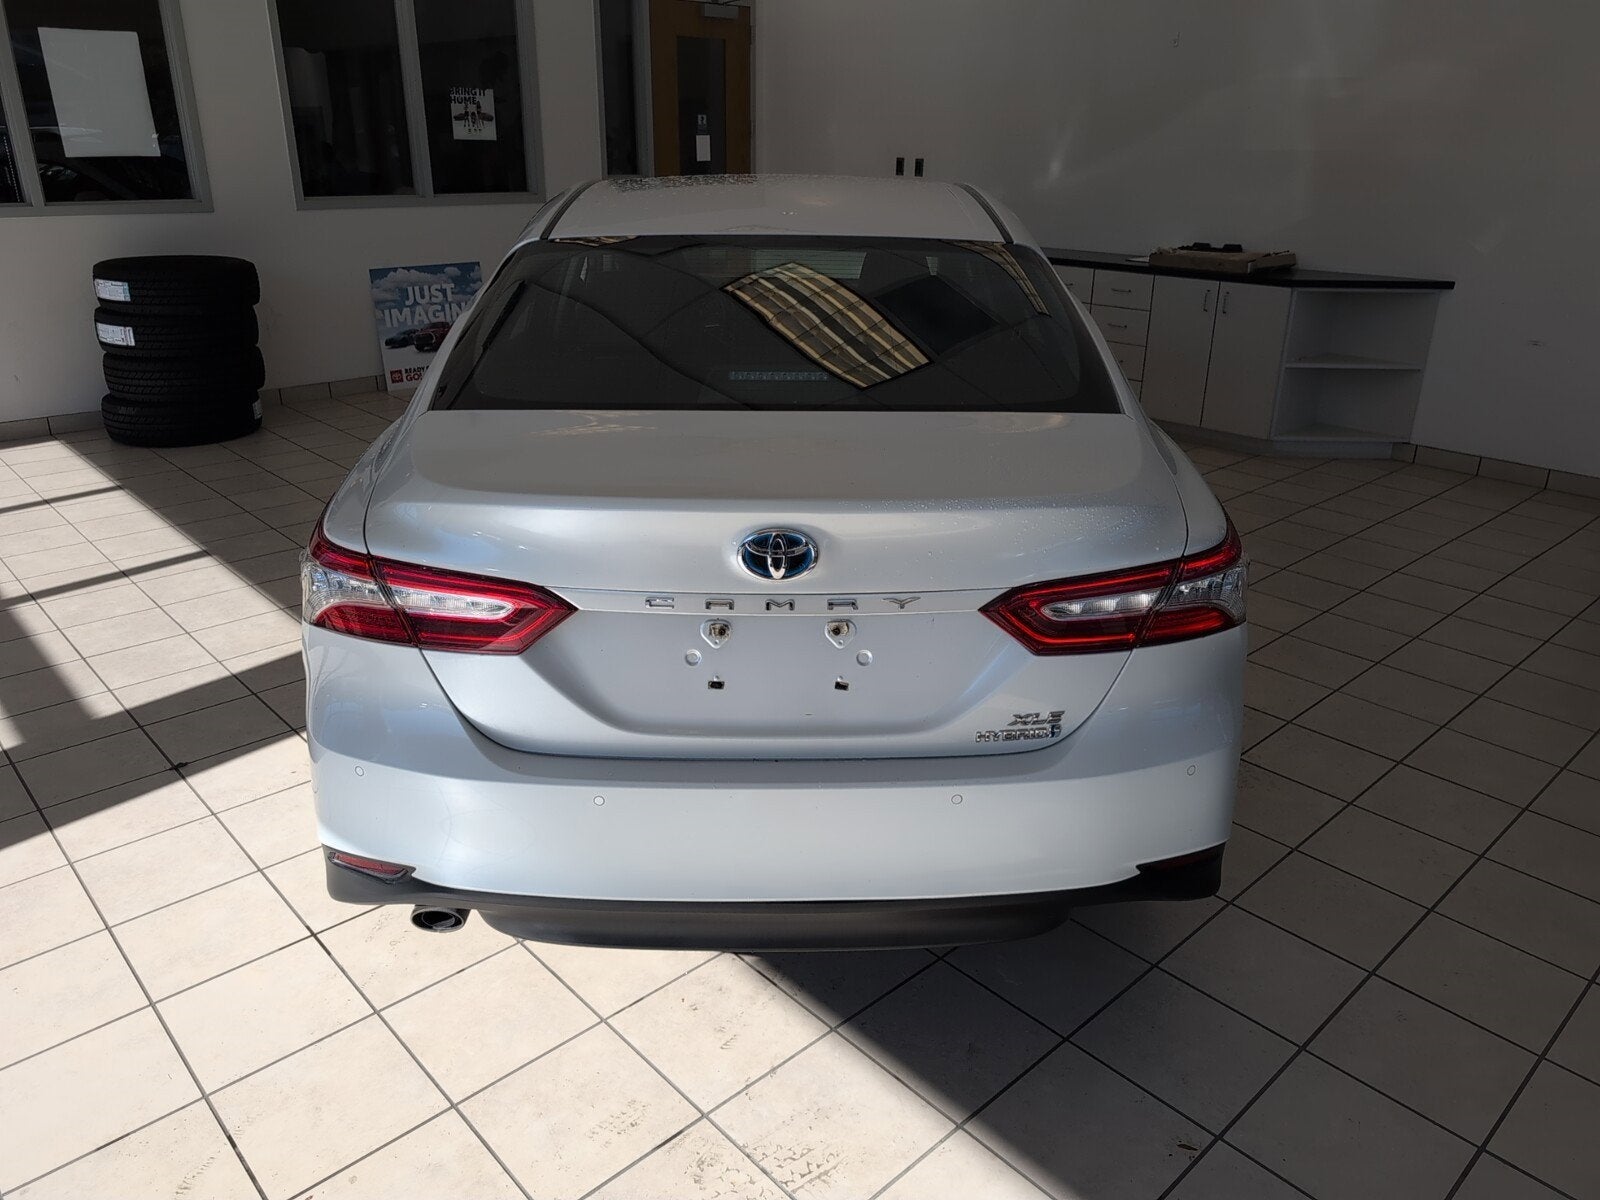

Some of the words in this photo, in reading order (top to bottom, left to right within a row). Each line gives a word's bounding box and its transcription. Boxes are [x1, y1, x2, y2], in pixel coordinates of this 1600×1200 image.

[450, 87, 478, 96] BRING
[450, 95, 477, 105] HOME
[405, 284, 454, 305] JUST
[384, 301, 471, 328] IMAGIN
[645, 596, 921, 611] CAMRY
[1007, 711, 1066, 726] XLE
[975, 727, 1051, 743] HYBRID
